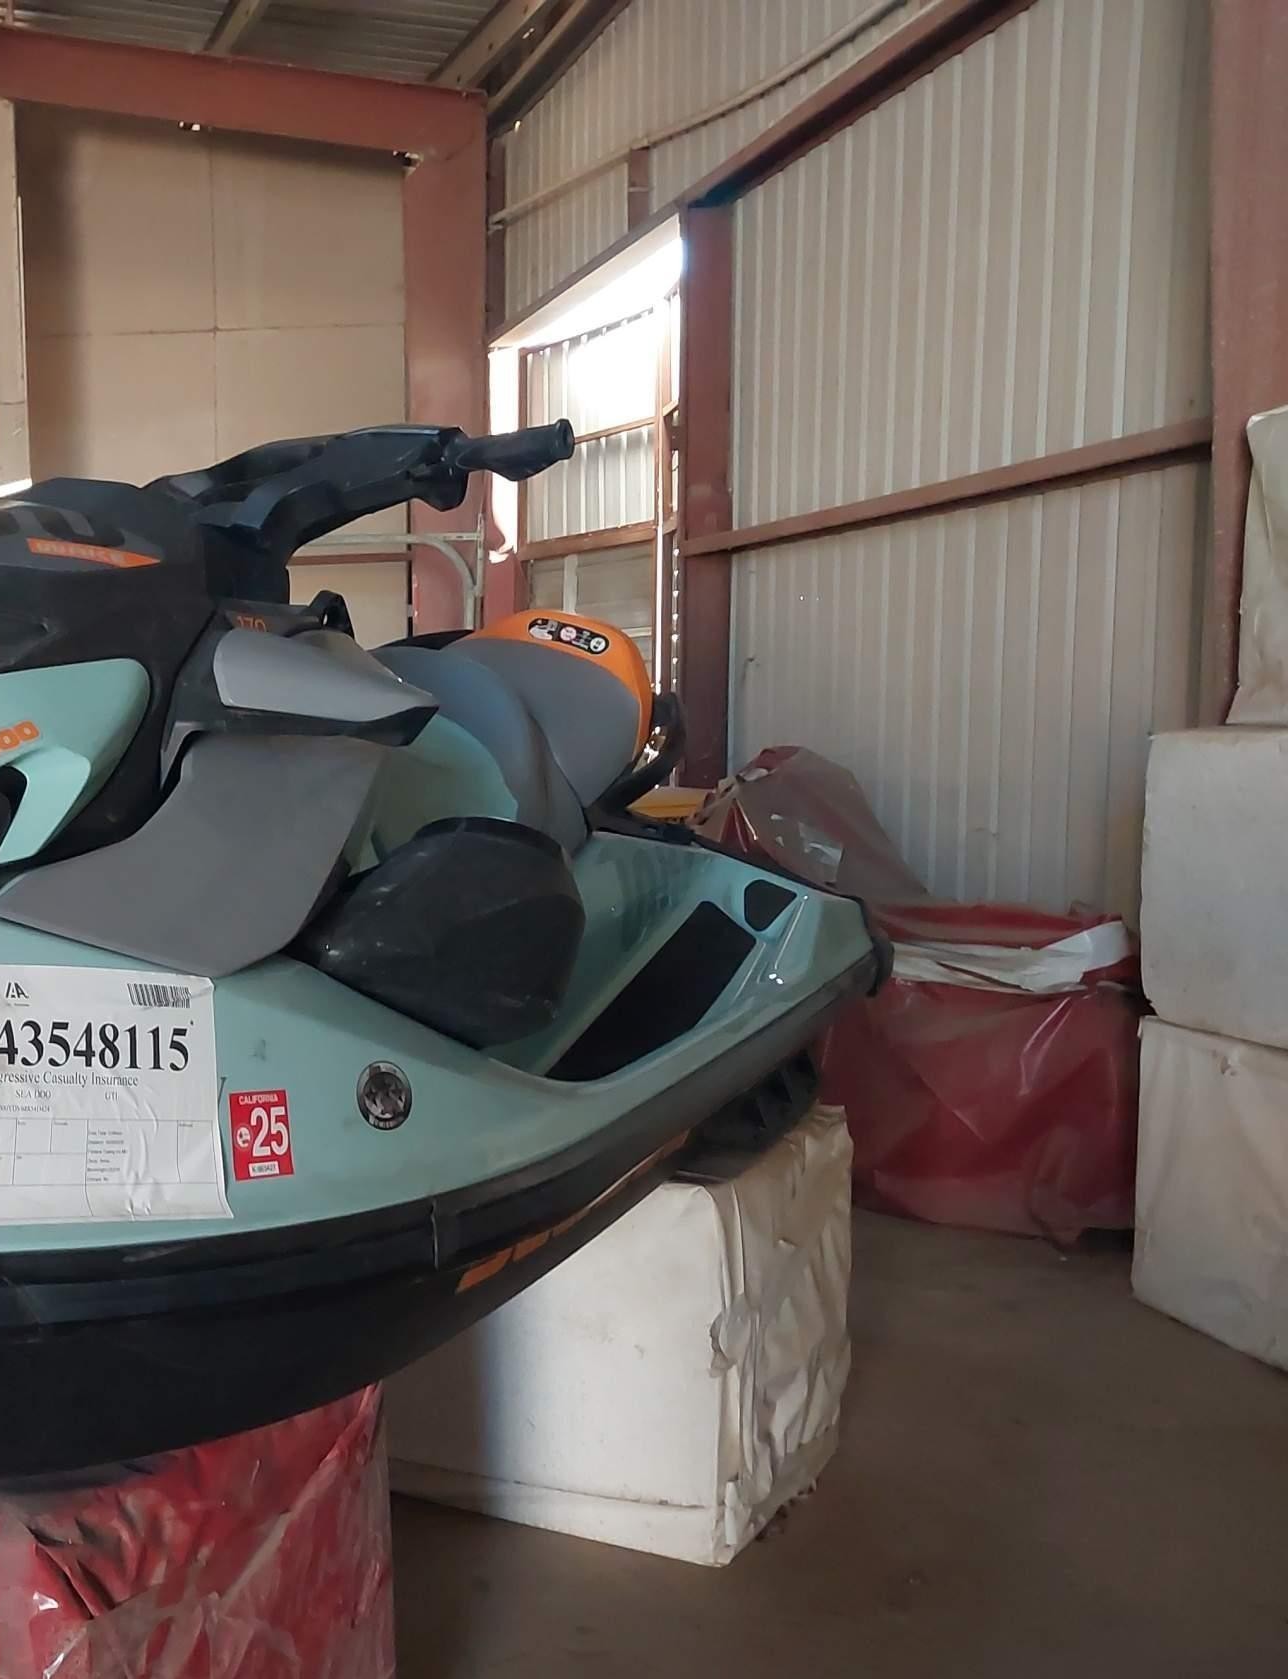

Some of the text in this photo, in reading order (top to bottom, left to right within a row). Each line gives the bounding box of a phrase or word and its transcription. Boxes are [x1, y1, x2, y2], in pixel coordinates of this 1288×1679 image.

[43, 1071, 88, 1088] Casualty
[92, 1072, 138, 1086] Insurance
[15, 1088, 32, 1098] SEA
[238, 1093, 279, 1105] CALIFORNIA
[250, 1106, 289, 1157] 25
